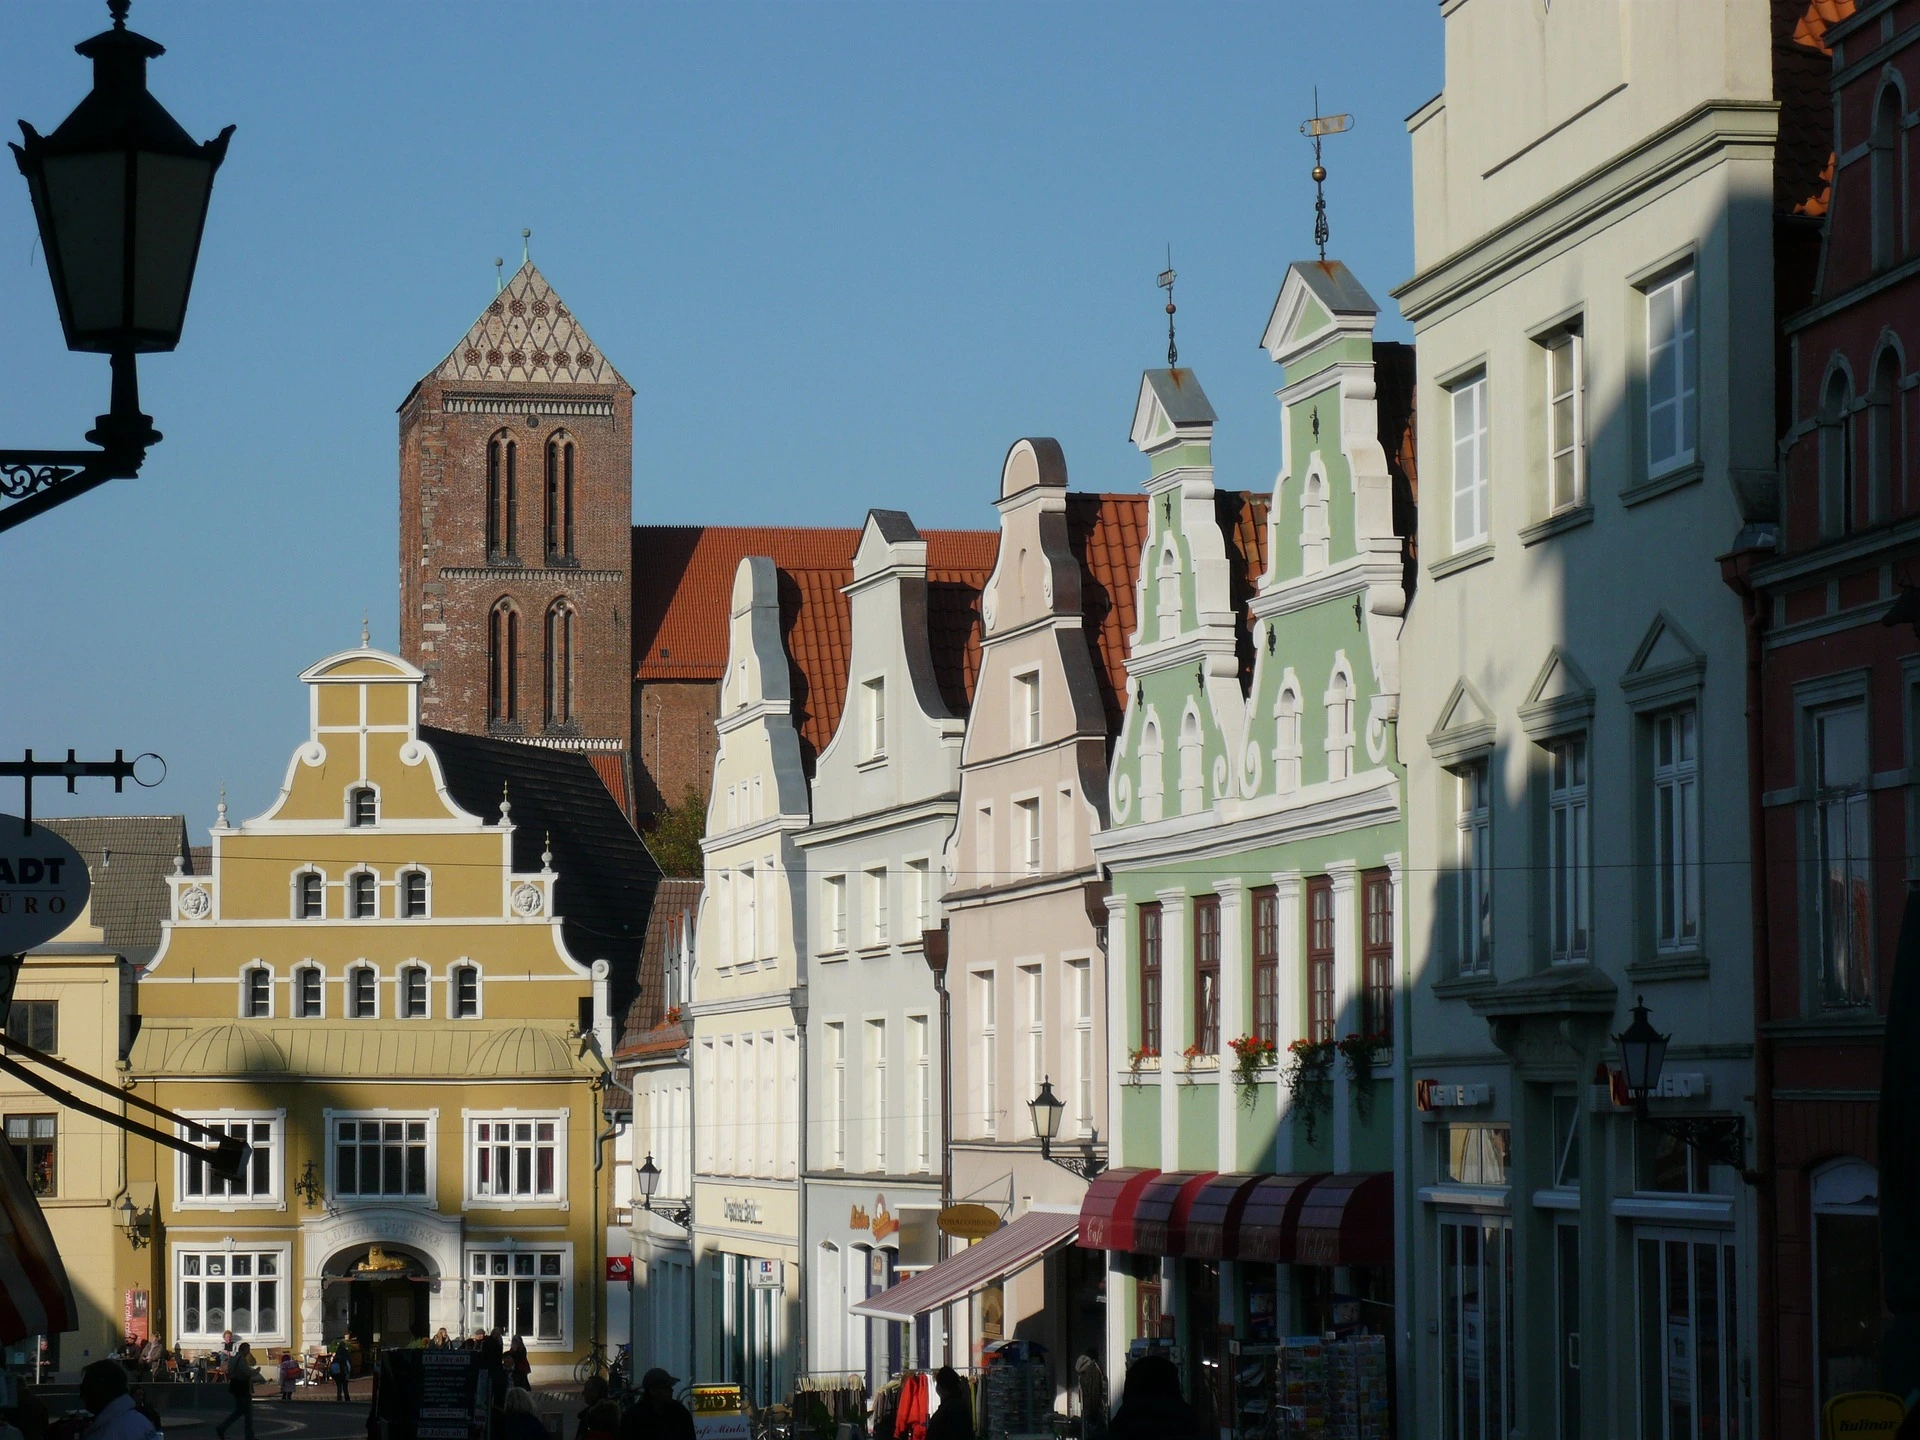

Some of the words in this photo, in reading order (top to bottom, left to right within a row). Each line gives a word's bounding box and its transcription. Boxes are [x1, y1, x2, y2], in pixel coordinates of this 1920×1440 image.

[0, 893, 65, 914] ÜRO
[185, 1259, 274, 1276] Wein
[476, 1258, 557, 1276] Café
